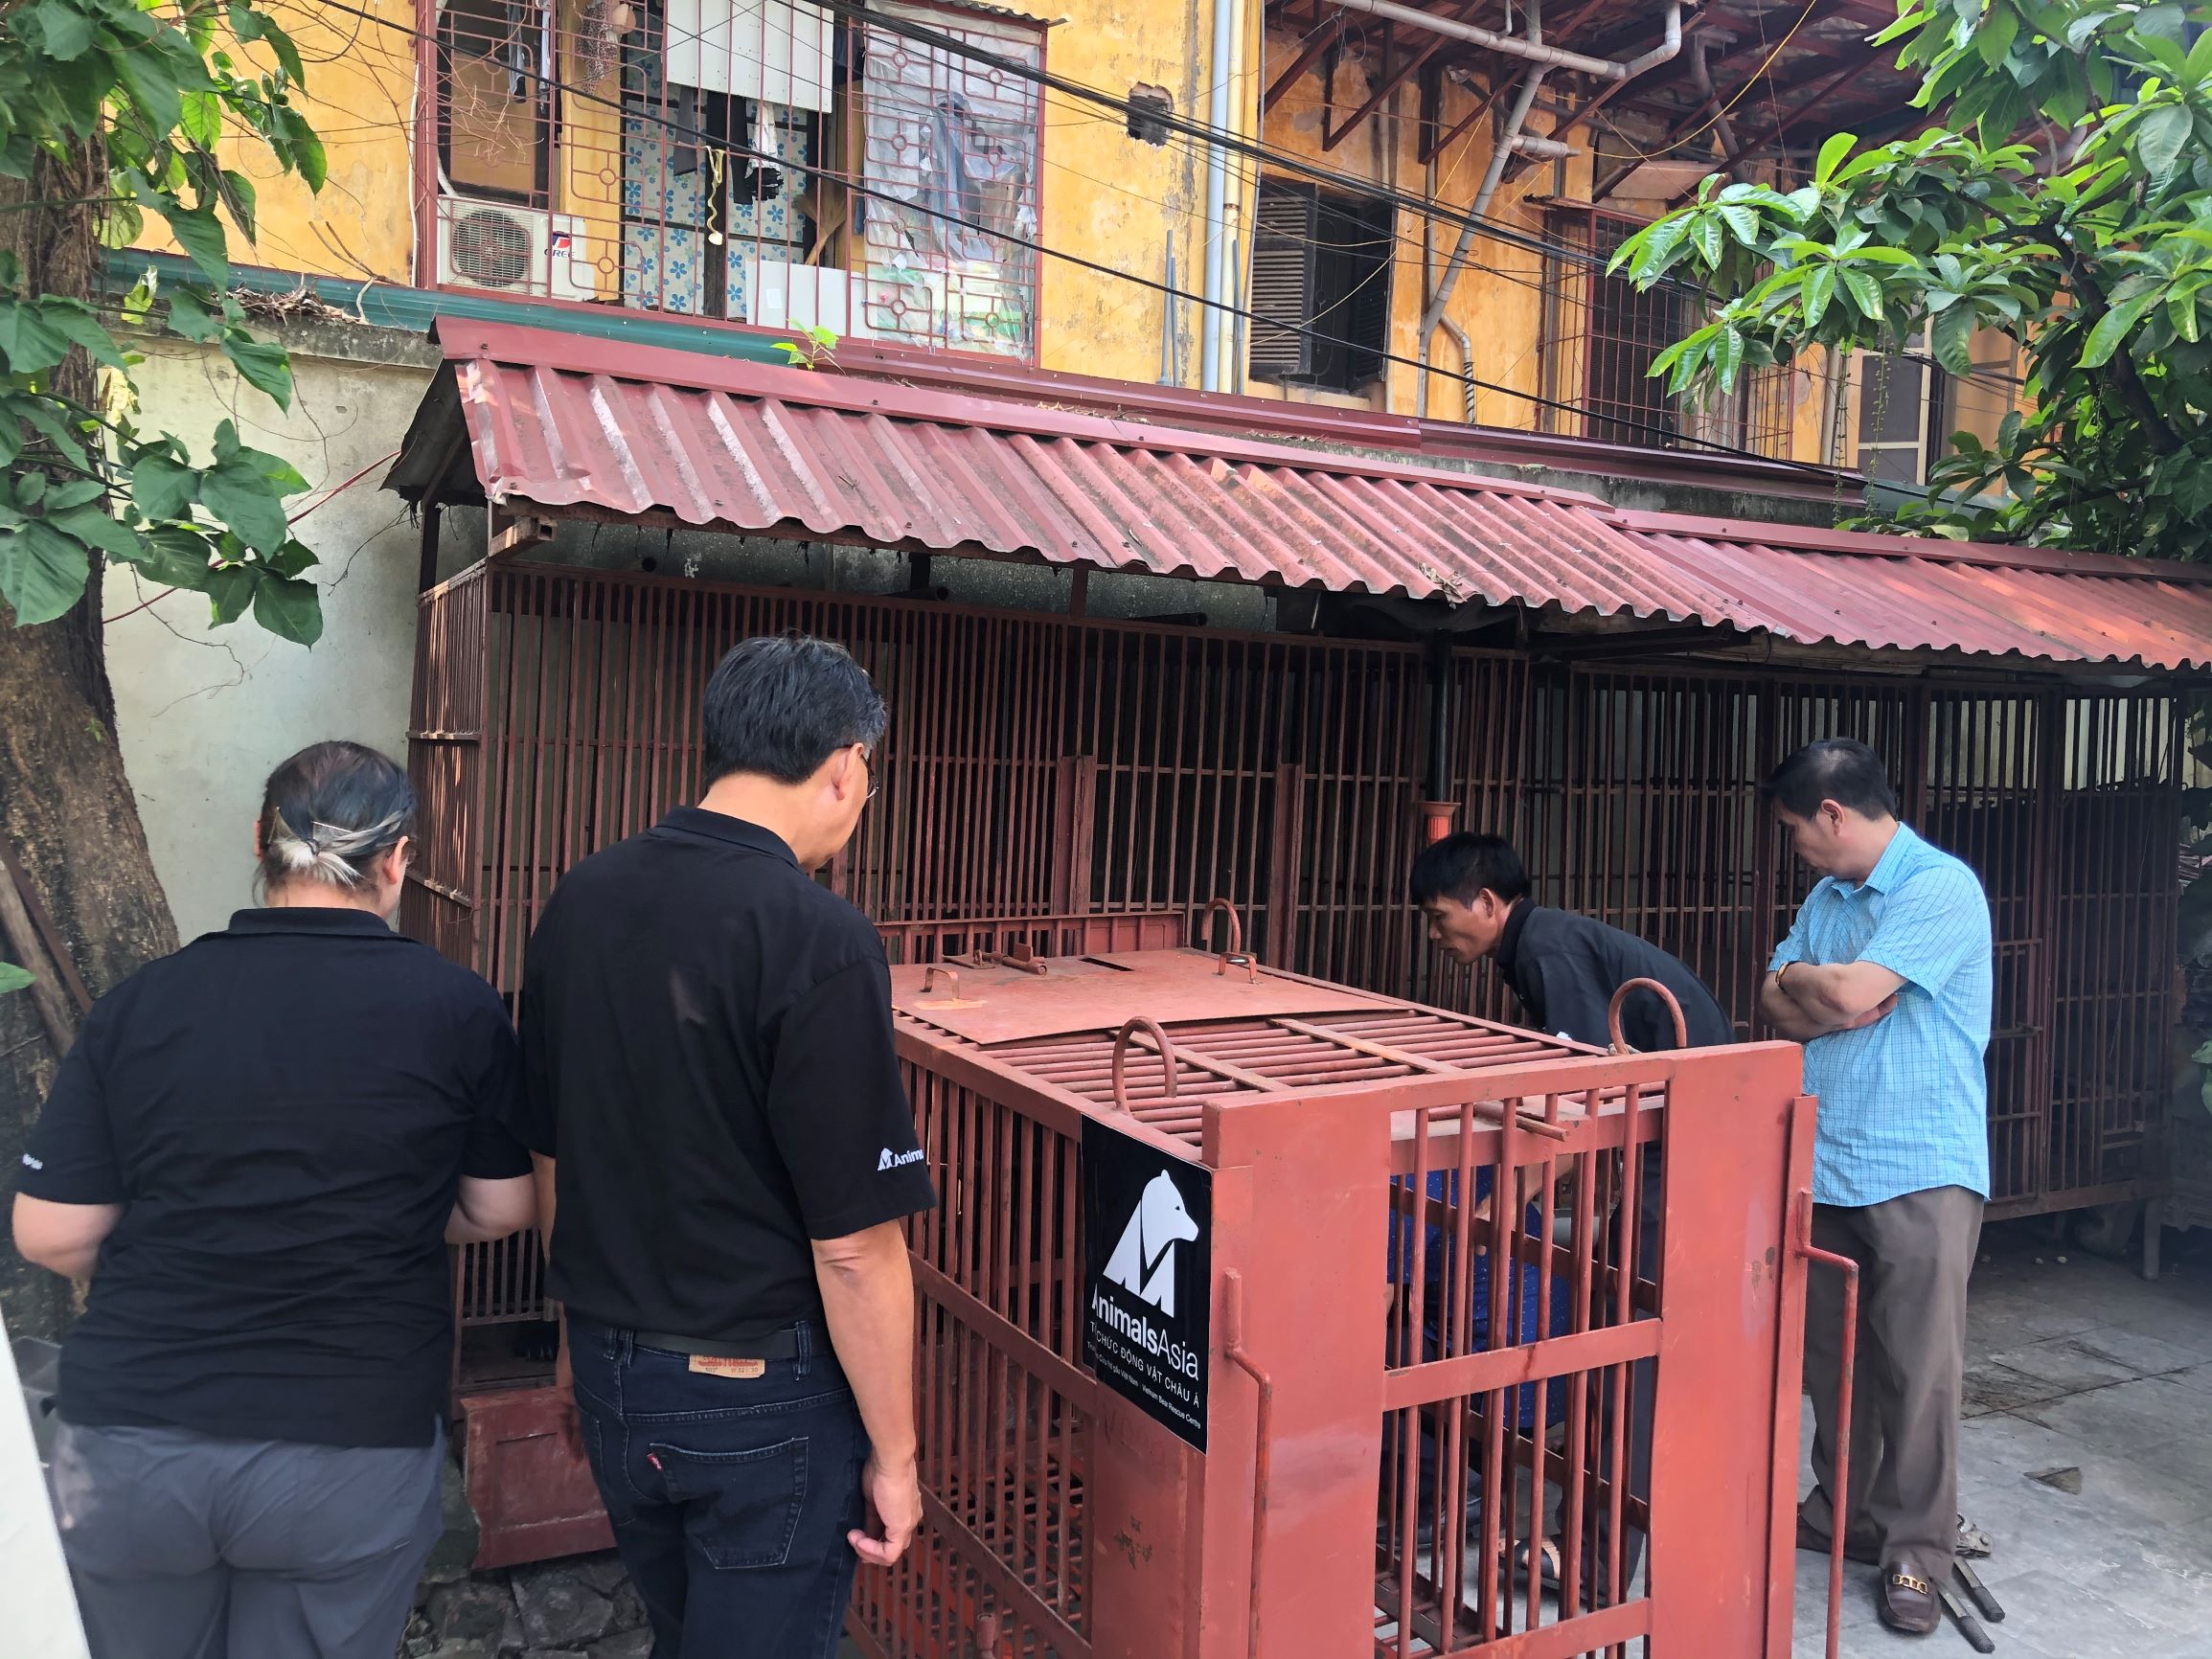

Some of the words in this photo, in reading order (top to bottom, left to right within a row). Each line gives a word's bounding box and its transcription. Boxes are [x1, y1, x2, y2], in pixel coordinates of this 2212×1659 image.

[1091, 1283, 1199, 1381] AnimalsAsia
[1096, 1330, 1119, 1354] CHỨC
[1120, 1347, 1144, 1372] ĐỘNG
[1146, 1363, 1163, 1384] VẬT
[1164, 1376, 1191, 1402] CHÂU
